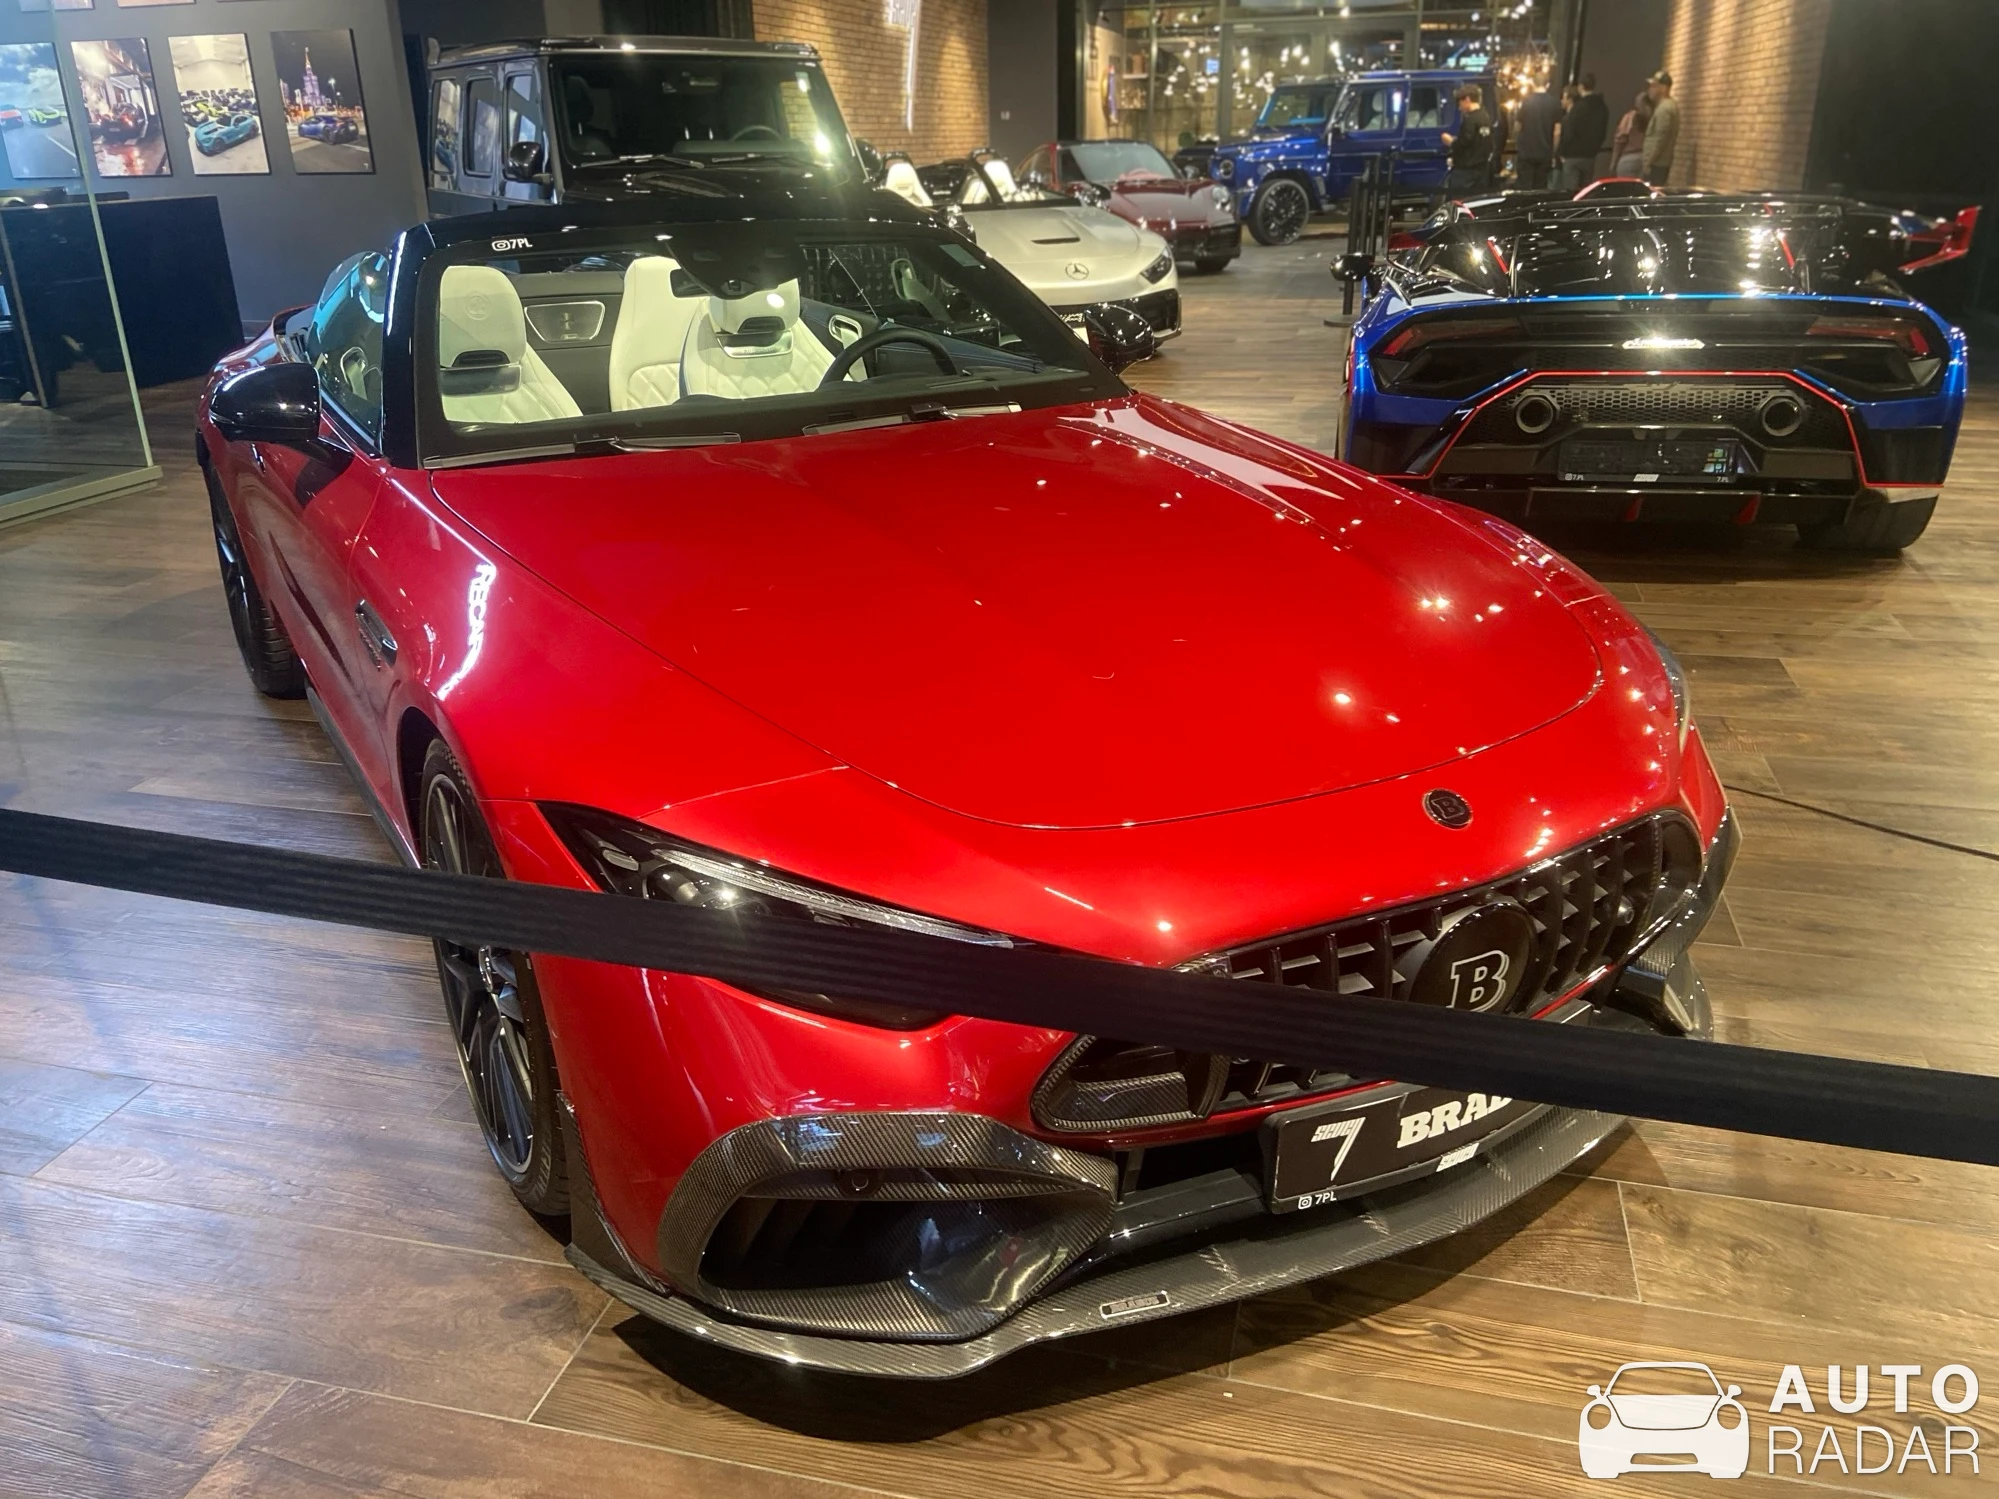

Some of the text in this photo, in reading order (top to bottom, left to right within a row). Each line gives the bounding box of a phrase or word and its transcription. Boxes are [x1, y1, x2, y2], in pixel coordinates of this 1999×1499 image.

[509, 238, 533, 249] 7PL
[1446, 950, 1509, 1012] B
[1314, 1191, 1337, 1204] 7PL
